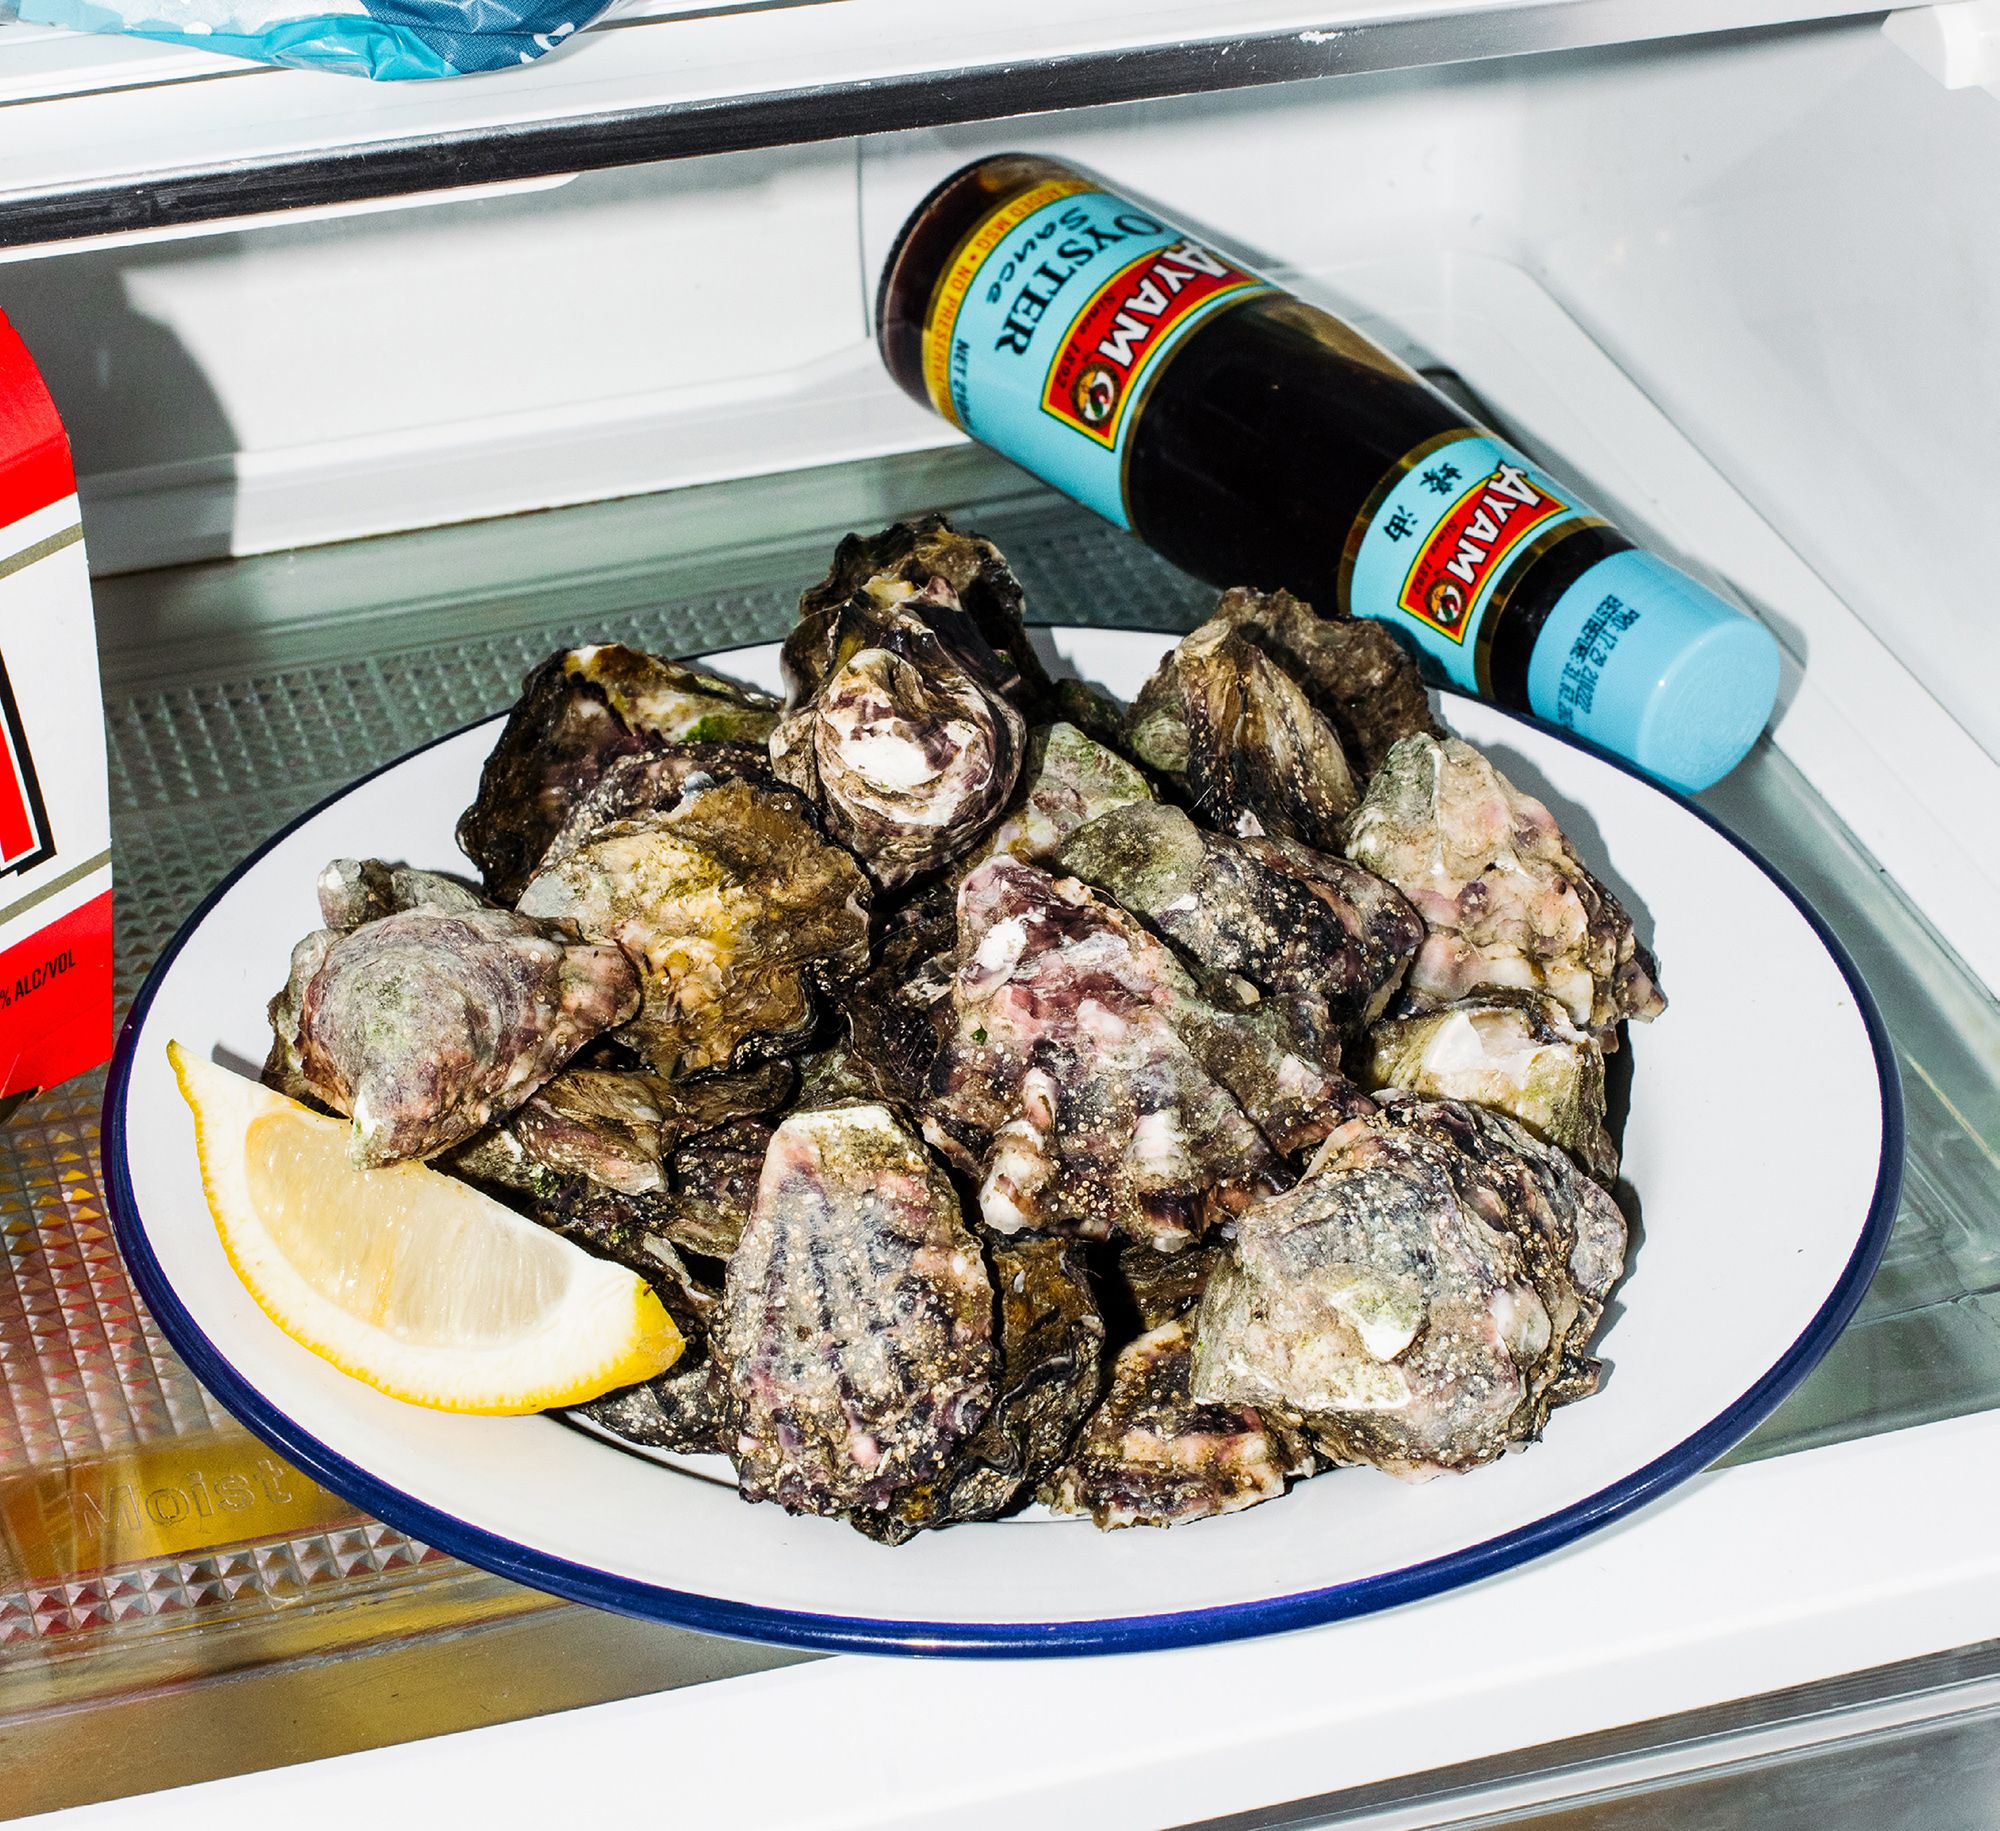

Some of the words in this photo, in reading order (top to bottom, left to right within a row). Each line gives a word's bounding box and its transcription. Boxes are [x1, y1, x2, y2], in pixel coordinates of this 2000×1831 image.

[974, 218, 1012, 250] MSG
[985, 206, 1089, 304] Sauce
[950, 265, 972, 291] NO
[995, 213, 1164, 356] OYSTER
[1079, 291, 1116, 335] Since
[1097, 237, 1231, 369] AYAM
[953, 338, 970, 378] NET
[1055, 341, 1081, 389] 1892
[1430, 518, 1459, 555] Since
[1445, 460, 1542, 587] AYAM
[1412, 558, 1433, 595] 1892
[14, 947, 77, 1002] ALC/VOL
[67, 1458, 293, 1539] Moist
